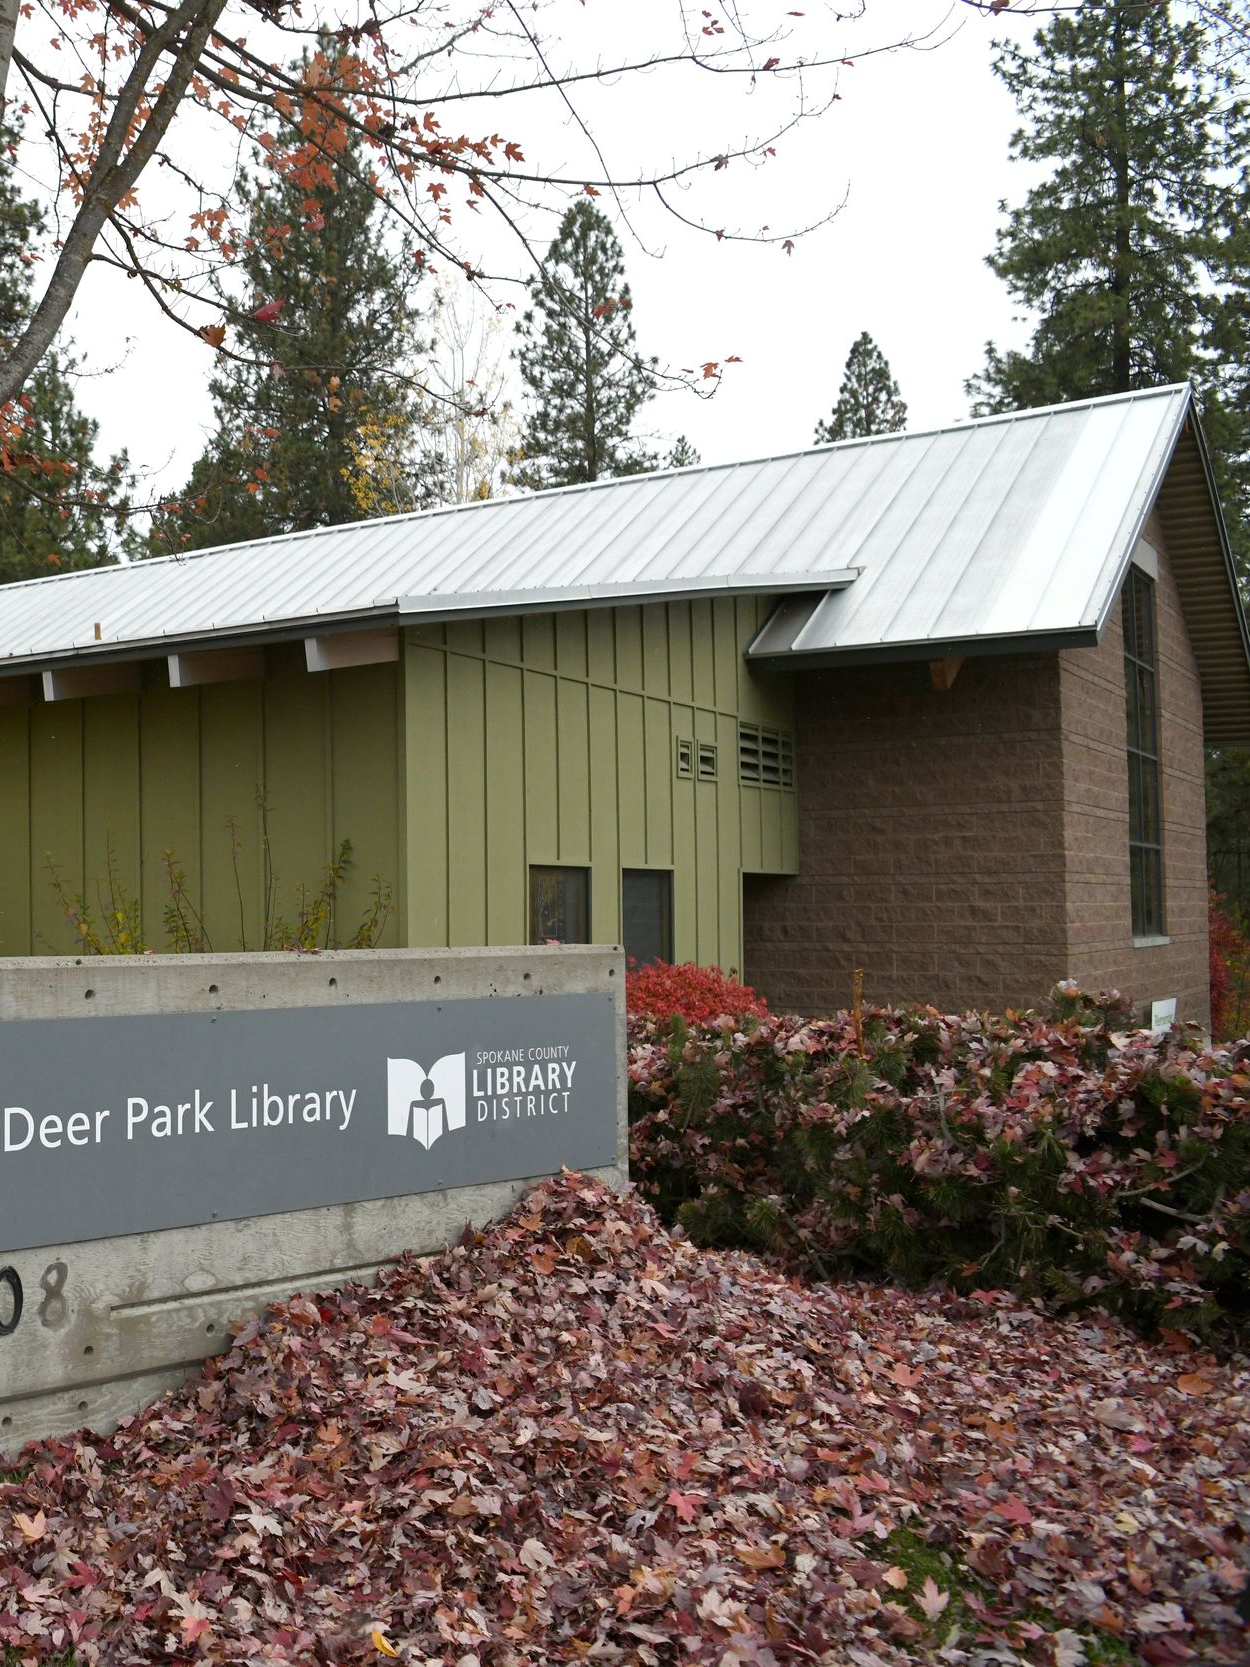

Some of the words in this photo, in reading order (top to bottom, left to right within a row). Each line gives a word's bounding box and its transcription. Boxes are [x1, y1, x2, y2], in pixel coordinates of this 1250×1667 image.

[476, 1049, 524, 1065] SPOKANE
[528, 1045, 570, 1060] COUNTY
[473, 1061, 577, 1096] LIBRARY
[3, 1106, 111, 1153] Deer
[127, 1088, 215, 1140] Park
[230, 1084, 357, 1131] Library
[477, 1092, 571, 1121] DISTRICT
